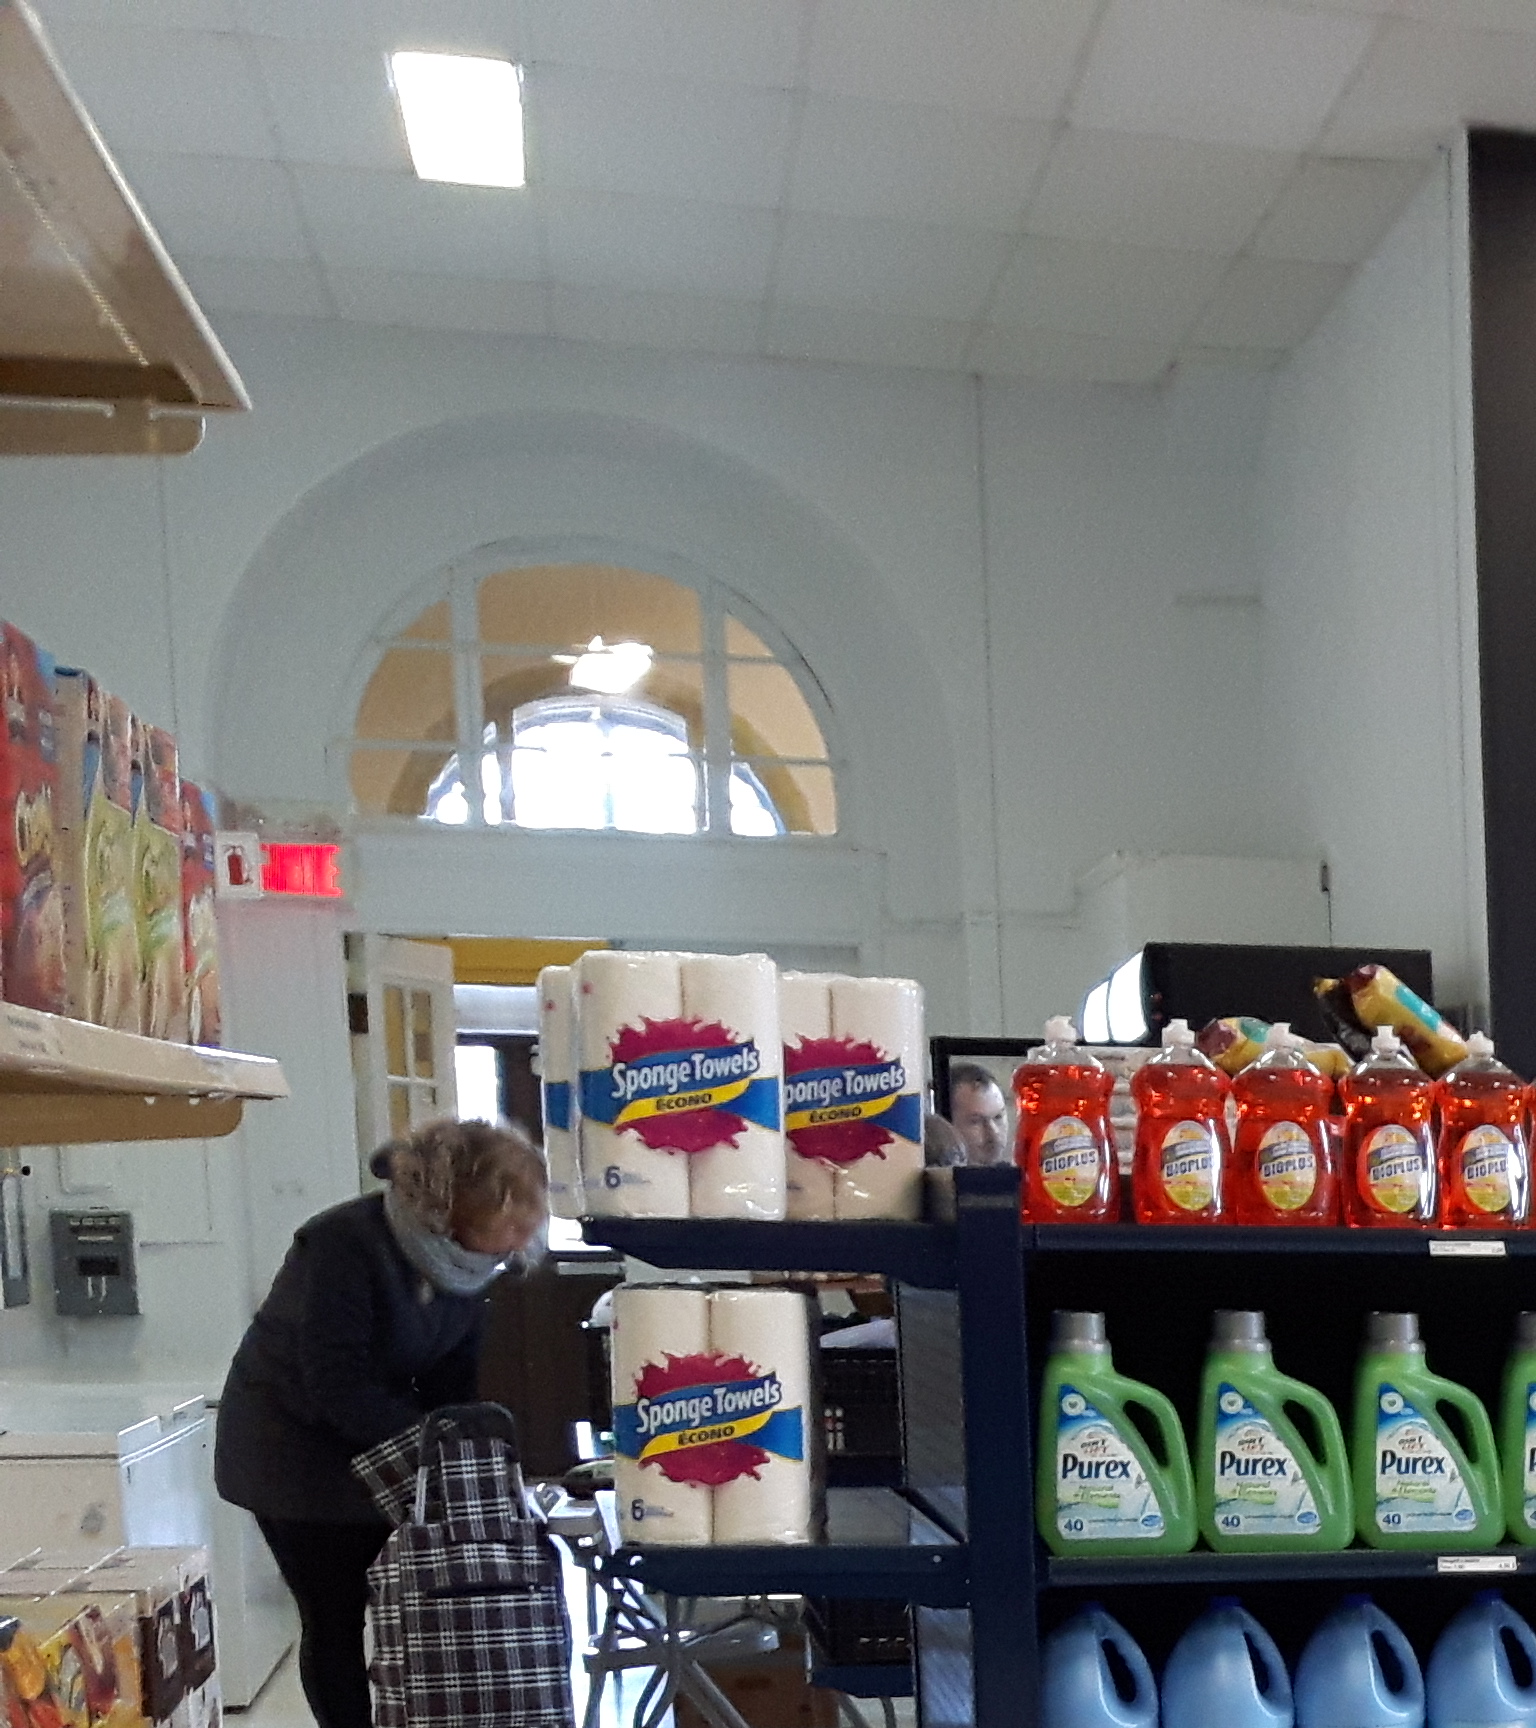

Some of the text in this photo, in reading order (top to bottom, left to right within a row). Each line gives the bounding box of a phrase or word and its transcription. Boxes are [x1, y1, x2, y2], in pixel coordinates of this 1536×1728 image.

[604, 1165, 621, 1189] 6
[1262, 1153, 1315, 1178] BIOPLUS
[1370, 1156, 1422, 1181] BIOPLUS
[1061, 1453, 1131, 1480] Purex
[1219, 1450, 1288, 1479] Purex
[1380, 1449, 1447, 1477] Purex
[1064, 1518, 1084, 1532] 40
[1221, 1514, 1241, 1529] 40
[1382, 1512, 1402, 1527] 40
